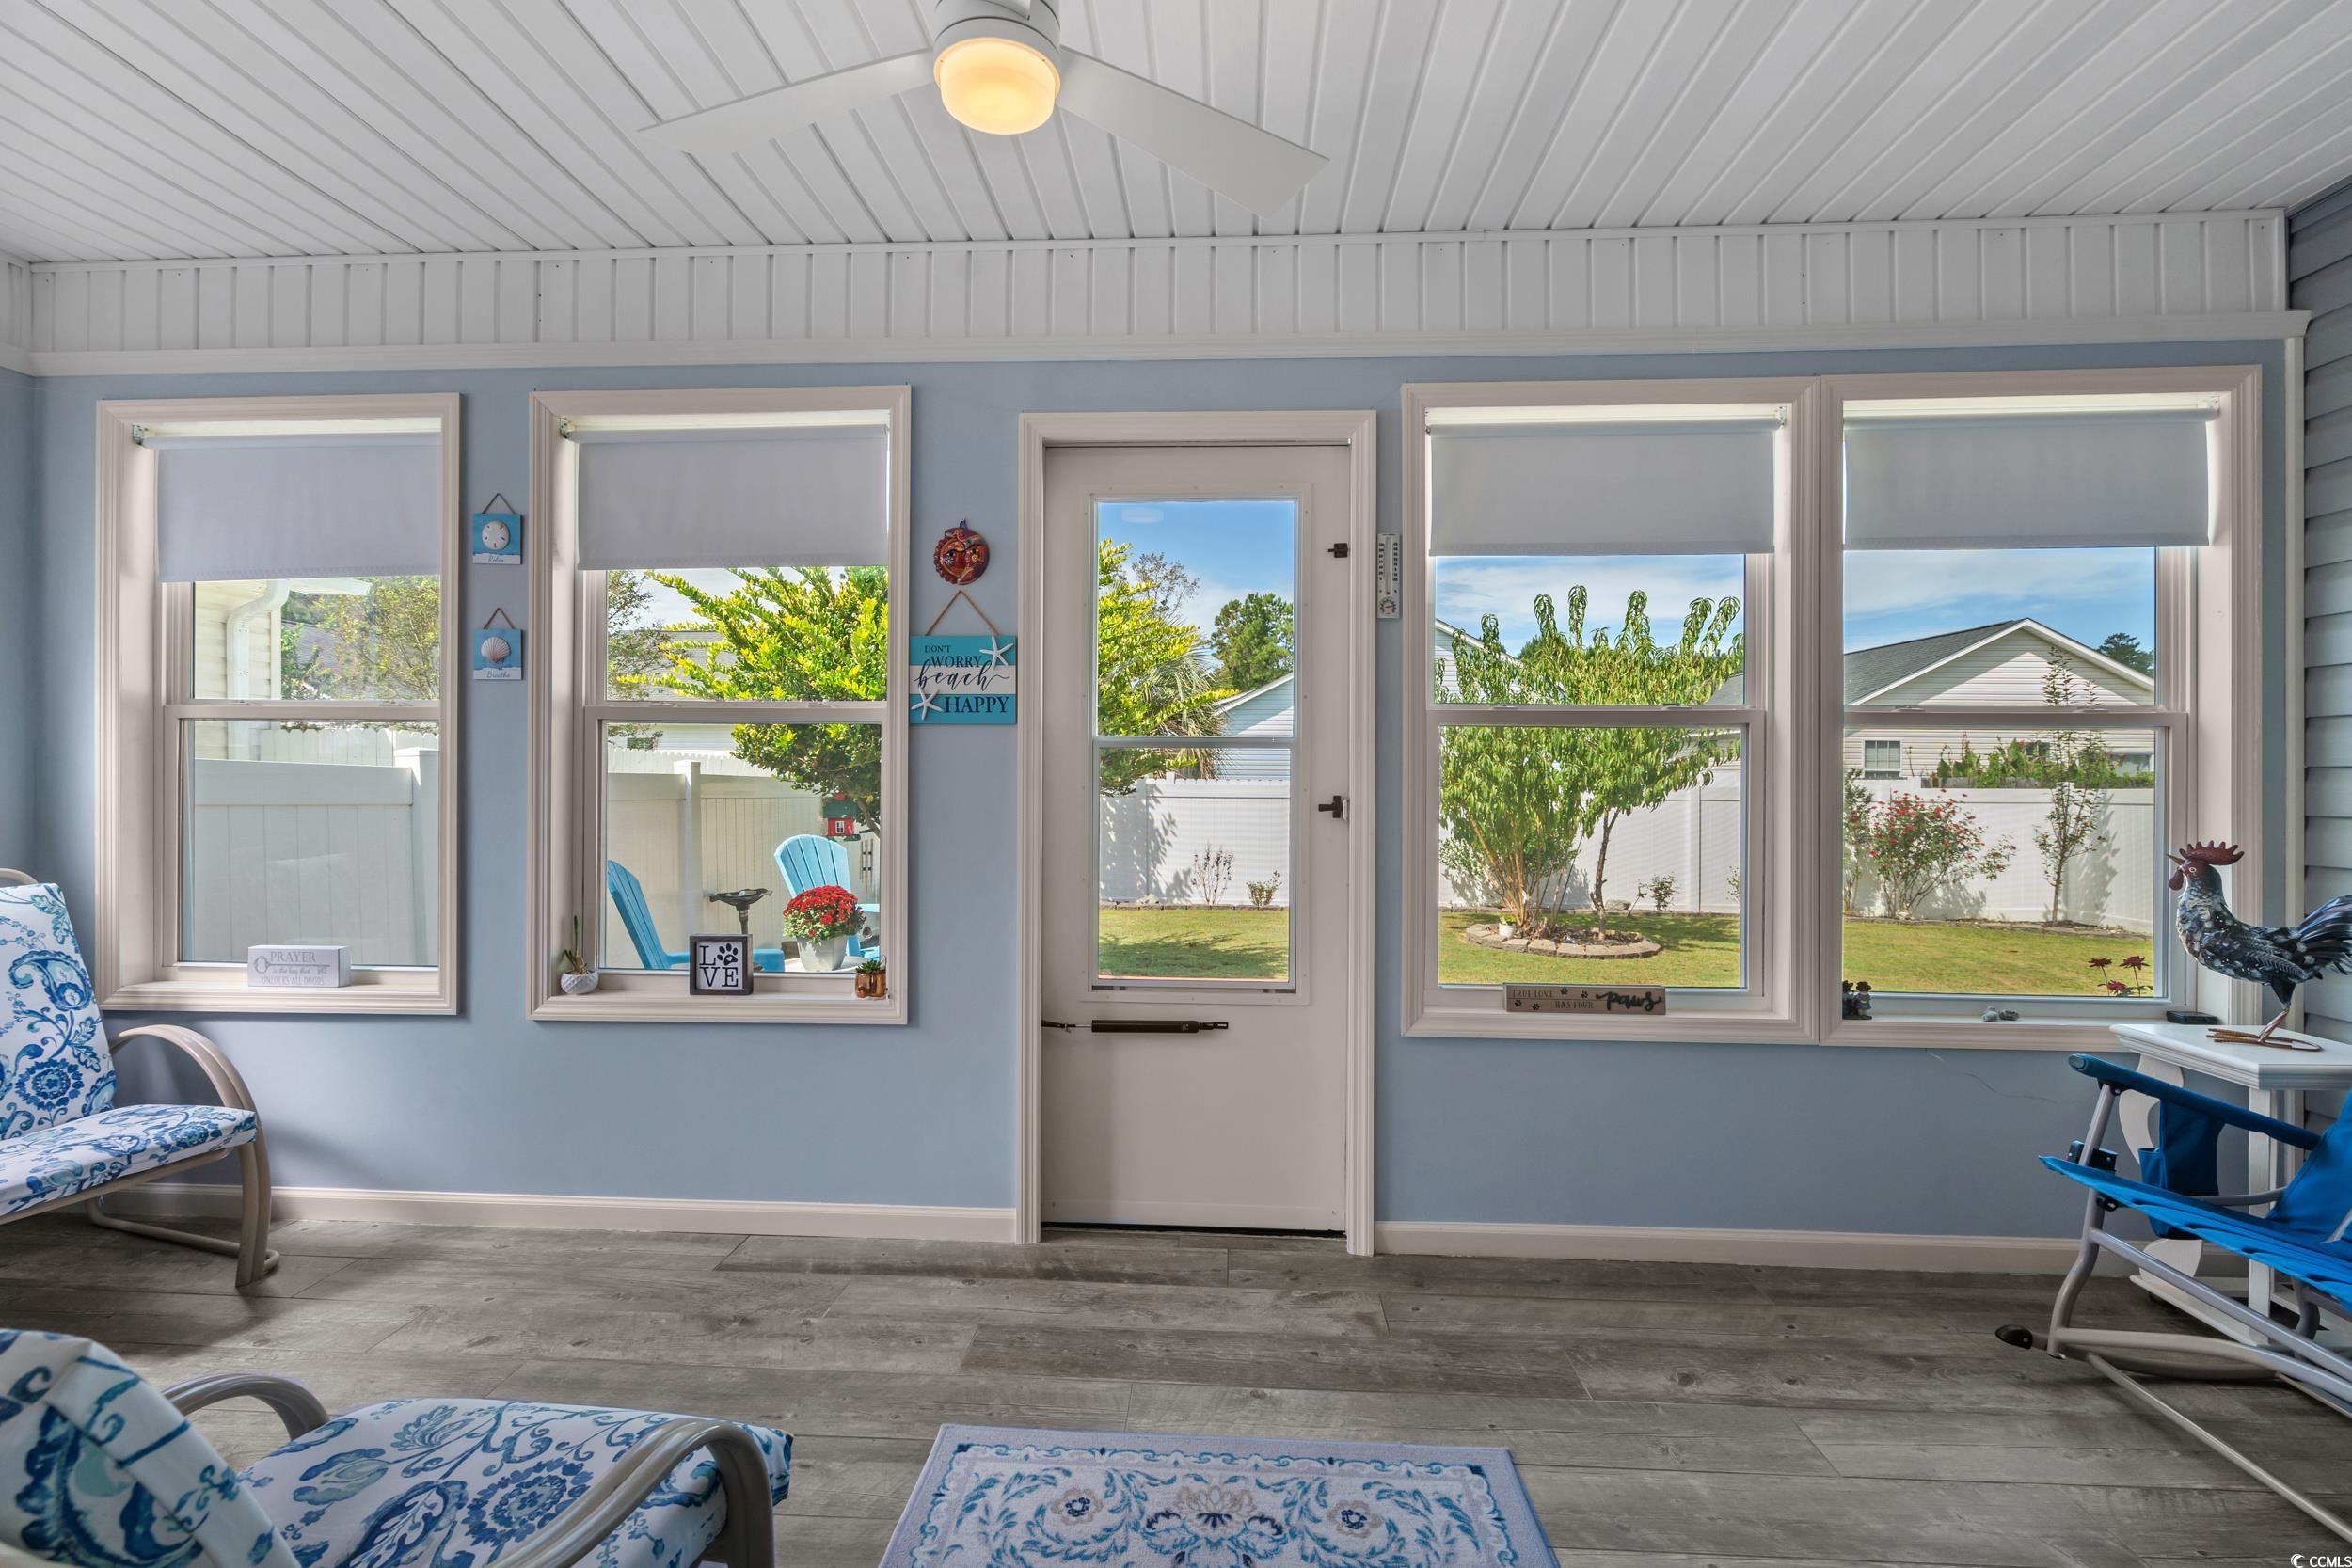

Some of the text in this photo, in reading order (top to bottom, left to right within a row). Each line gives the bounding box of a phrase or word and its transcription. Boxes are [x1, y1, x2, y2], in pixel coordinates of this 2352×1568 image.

[924, 644, 951, 653] DON'T
[930, 656, 982, 668] WORRY
[913, 658, 1011, 691] beach
[944, 696, 1009, 713] HAPPY
[270, 951, 316, 963] PRAYER
[291, 976, 301, 986] ALL
[1513, 990, 1553, 998] TRUE LOVE
[1554, 1000, 1594, 1009] HAS FOUR
[1596, 990, 1662, 1012] paws
